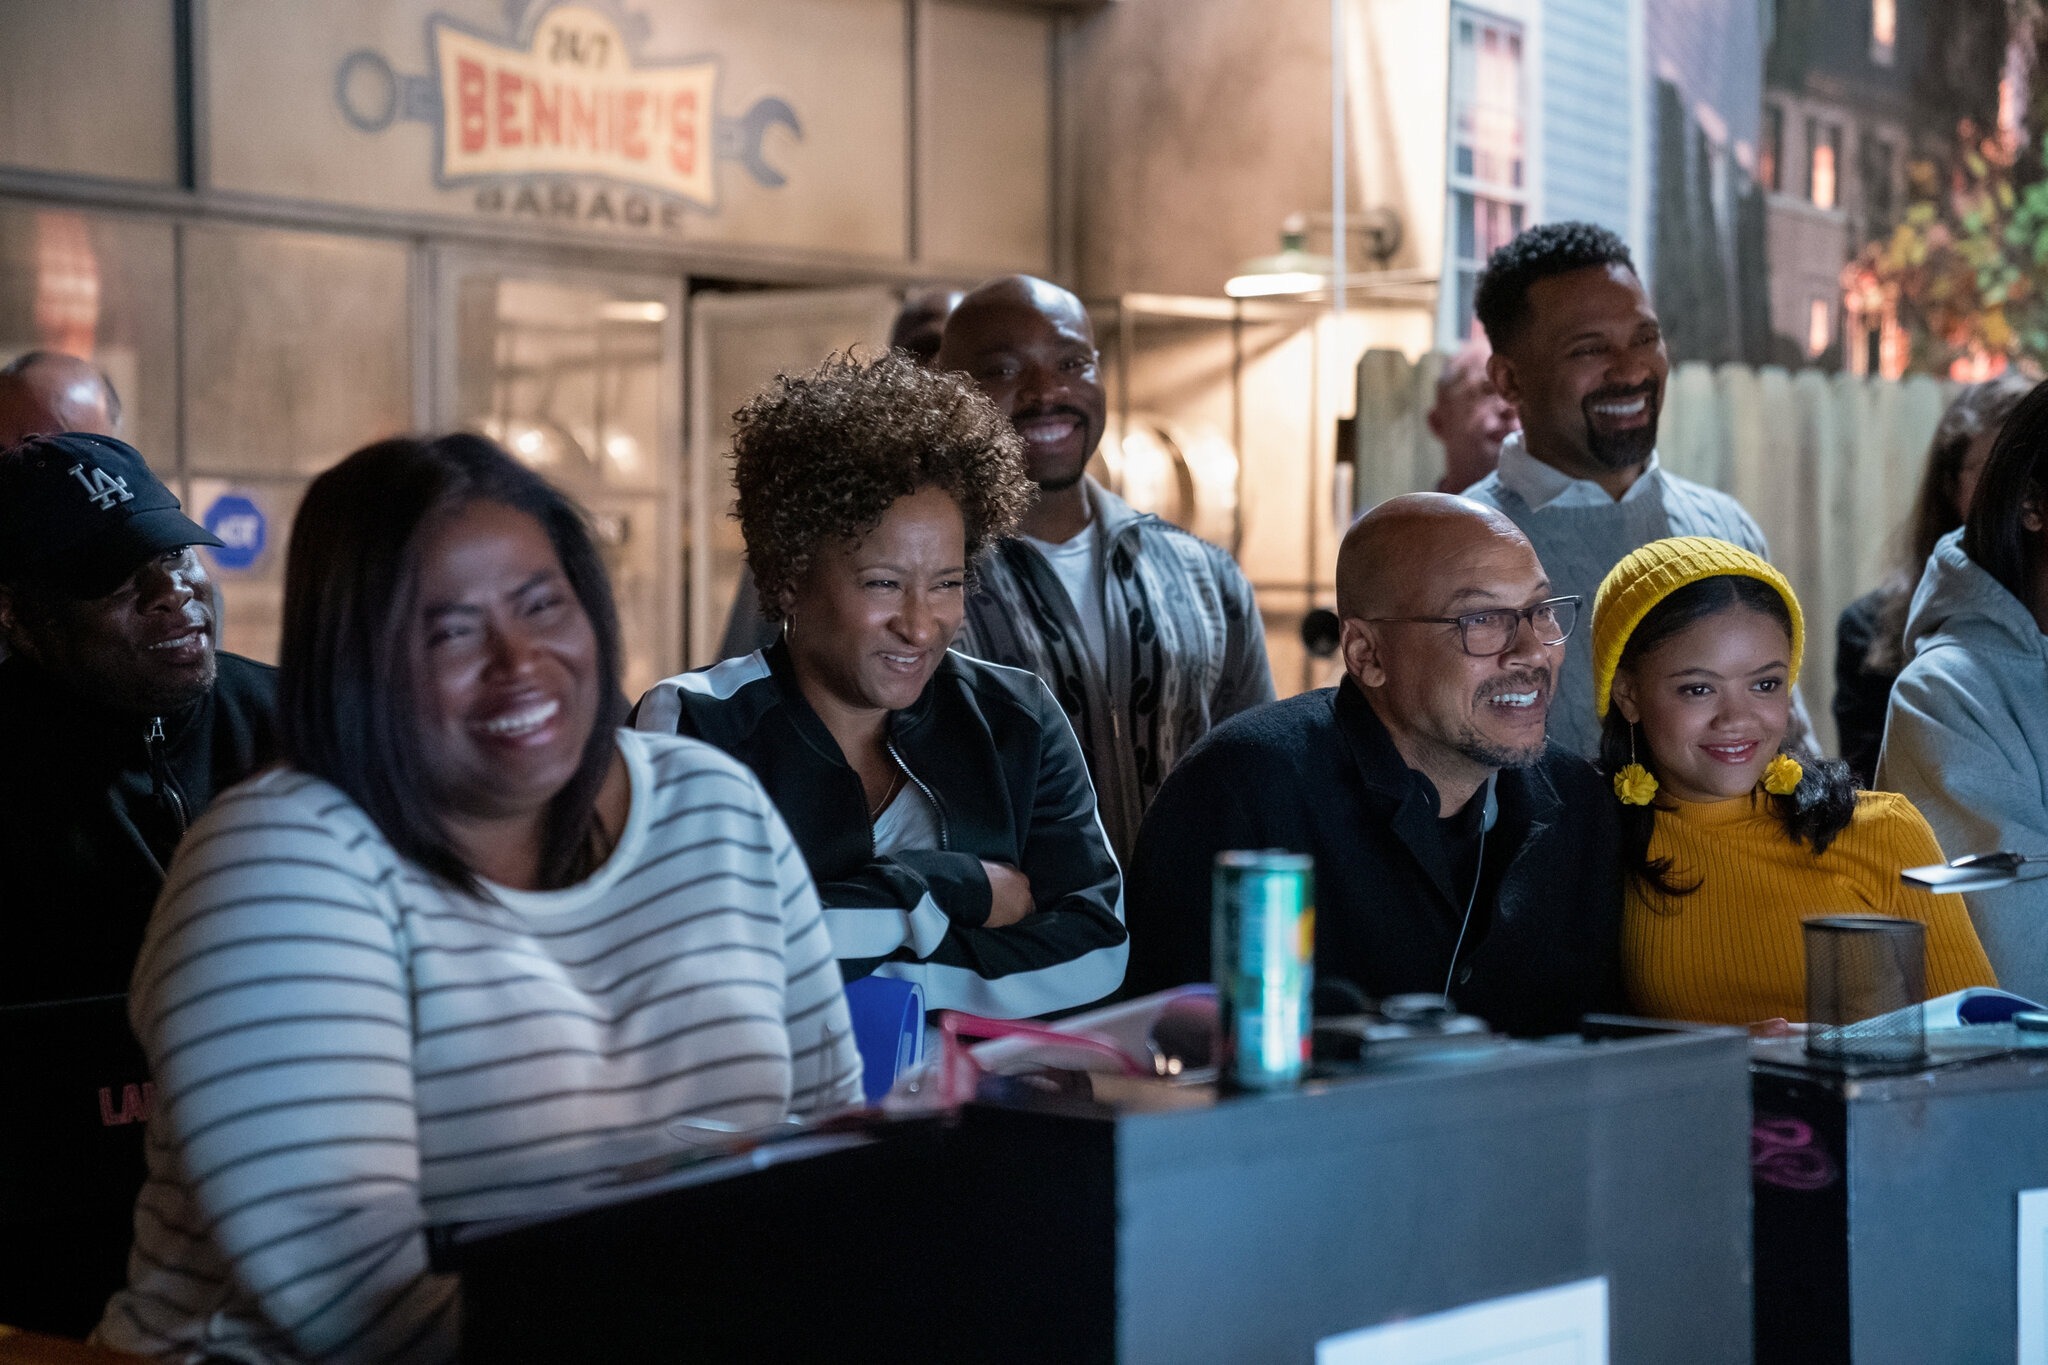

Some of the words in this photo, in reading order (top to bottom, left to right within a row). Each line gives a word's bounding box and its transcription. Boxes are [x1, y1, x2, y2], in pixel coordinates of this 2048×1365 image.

[457, 56, 697, 177] BENNIE'S
[474, 186, 685, 229] GARAGE
[68, 463, 134, 510] LA
